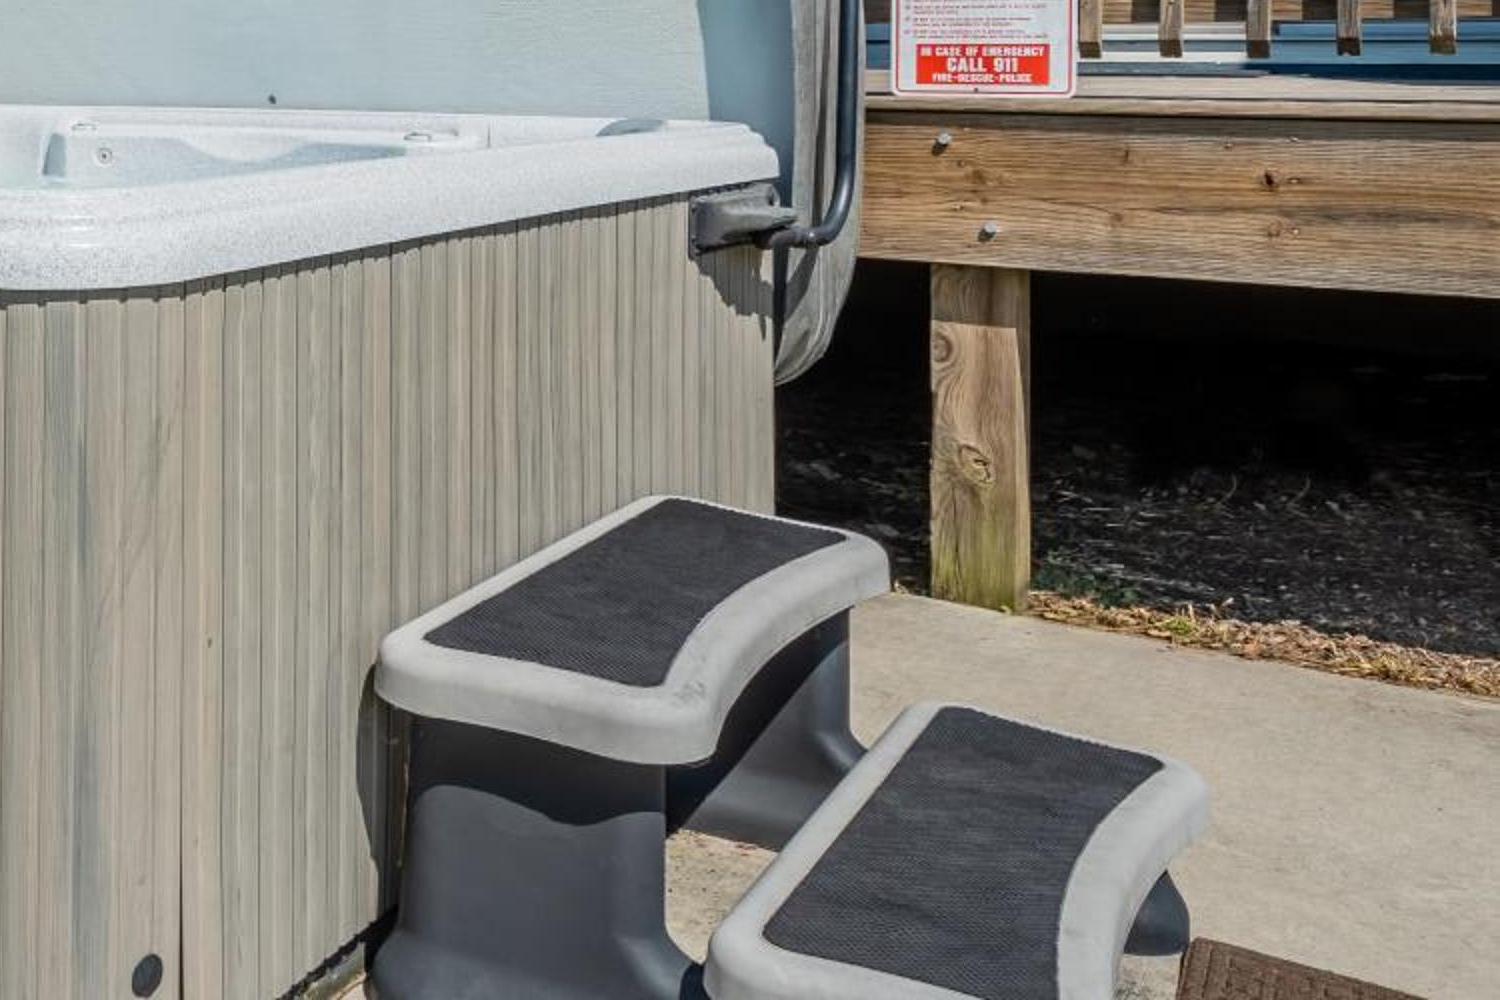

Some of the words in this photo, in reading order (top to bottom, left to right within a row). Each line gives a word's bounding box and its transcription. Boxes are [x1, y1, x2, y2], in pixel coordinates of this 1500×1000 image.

[965, 46, 979, 56] OF
[982, 46, 1045, 57] EMERGENCY
[947, 57, 987, 73] CALL
[994, 57, 1018, 73] 911
